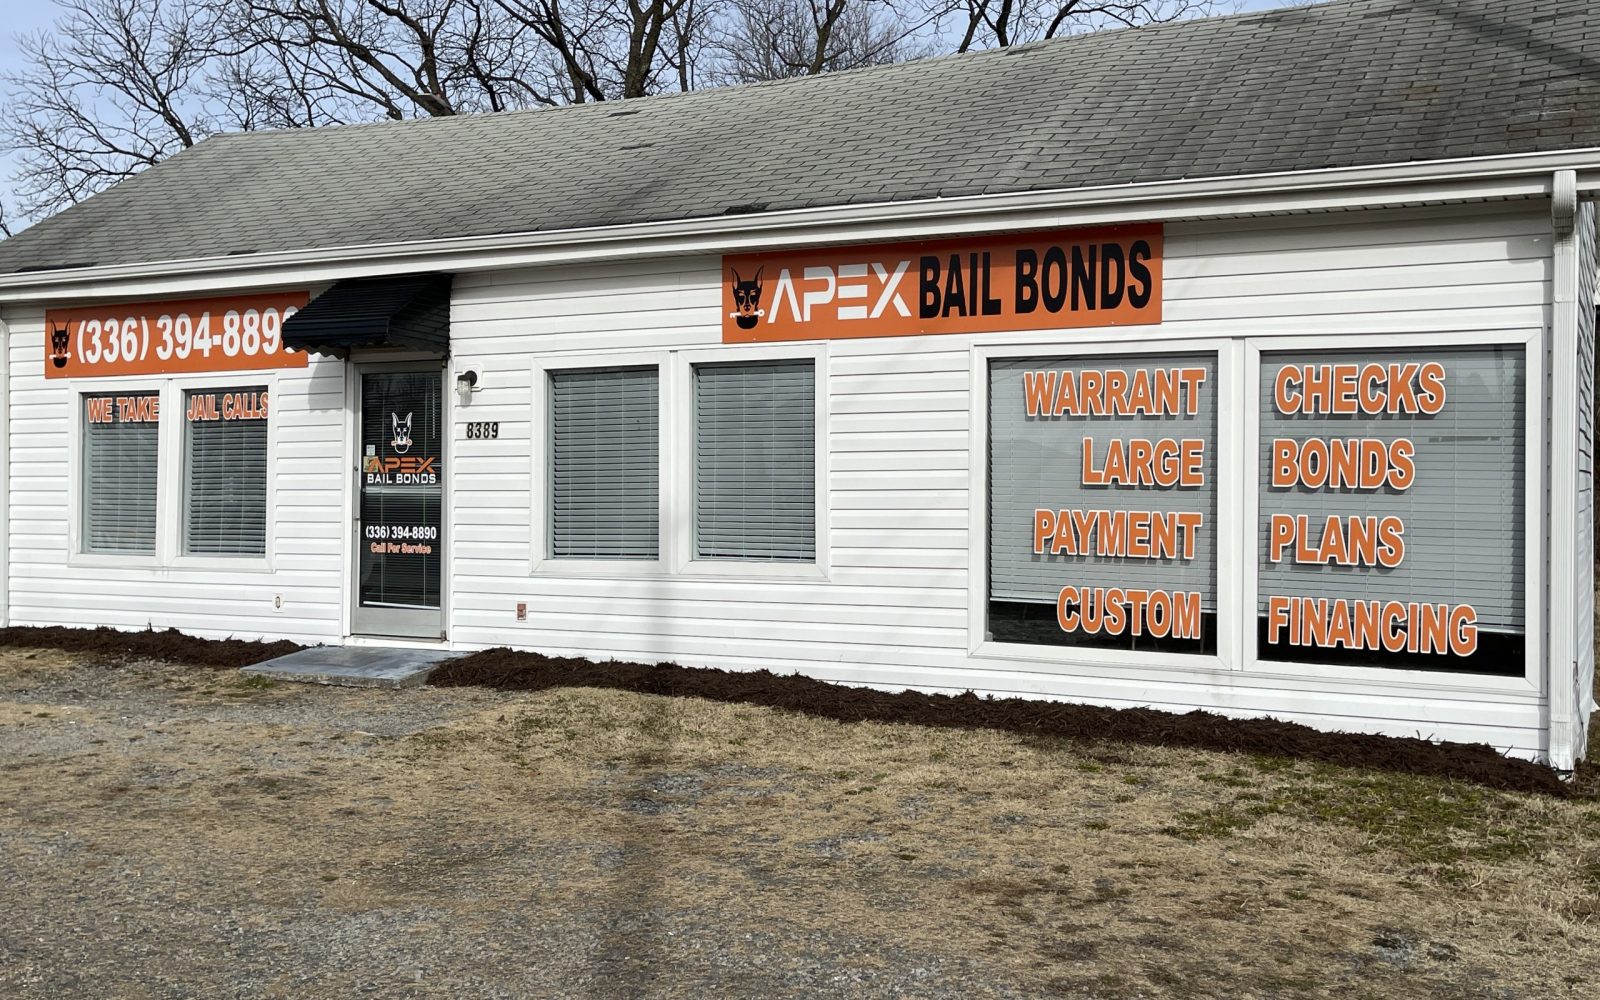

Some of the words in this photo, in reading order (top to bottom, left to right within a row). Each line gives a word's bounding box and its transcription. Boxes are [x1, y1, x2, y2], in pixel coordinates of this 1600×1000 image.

[767, 260, 912, 323] APEX
[918, 251, 1001, 319] BAIL
[1014, 240, 1152, 314] BONDS
[76, 315, 150, 364] (336)
[156, 305, 299, 361] 394-889
[87, 398, 113, 423] WE
[116, 396, 160, 422] TAKE
[187, 394, 220, 421] JAIL
[222, 392, 268, 420] CALLS
[1024, 368, 1206, 417] WARRANT
[1275, 362, 1446, 415] CHECKS
[466, 422, 499, 439] 8389
[367, 473, 392, 484] BAIL
[396, 473, 436, 484] BONDS
[368, 456, 436, 473] APEX
[1082, 437, 1204, 486] LARGE
[1272, 438, 1415, 490] BONDS
[365, 525, 390, 538] (336)
[391, 526, 437, 539] 394-8890
[370, 542, 386, 553] Call
[387, 542, 400, 553] For
[401, 542, 432, 554] Service
[1034, 509, 1202, 559] PAYMENT
[1270, 514, 1405, 568] PLANS
[1057, 586, 1201, 639] CUSTOM
[1268, 596, 1478, 657] FINANCING
